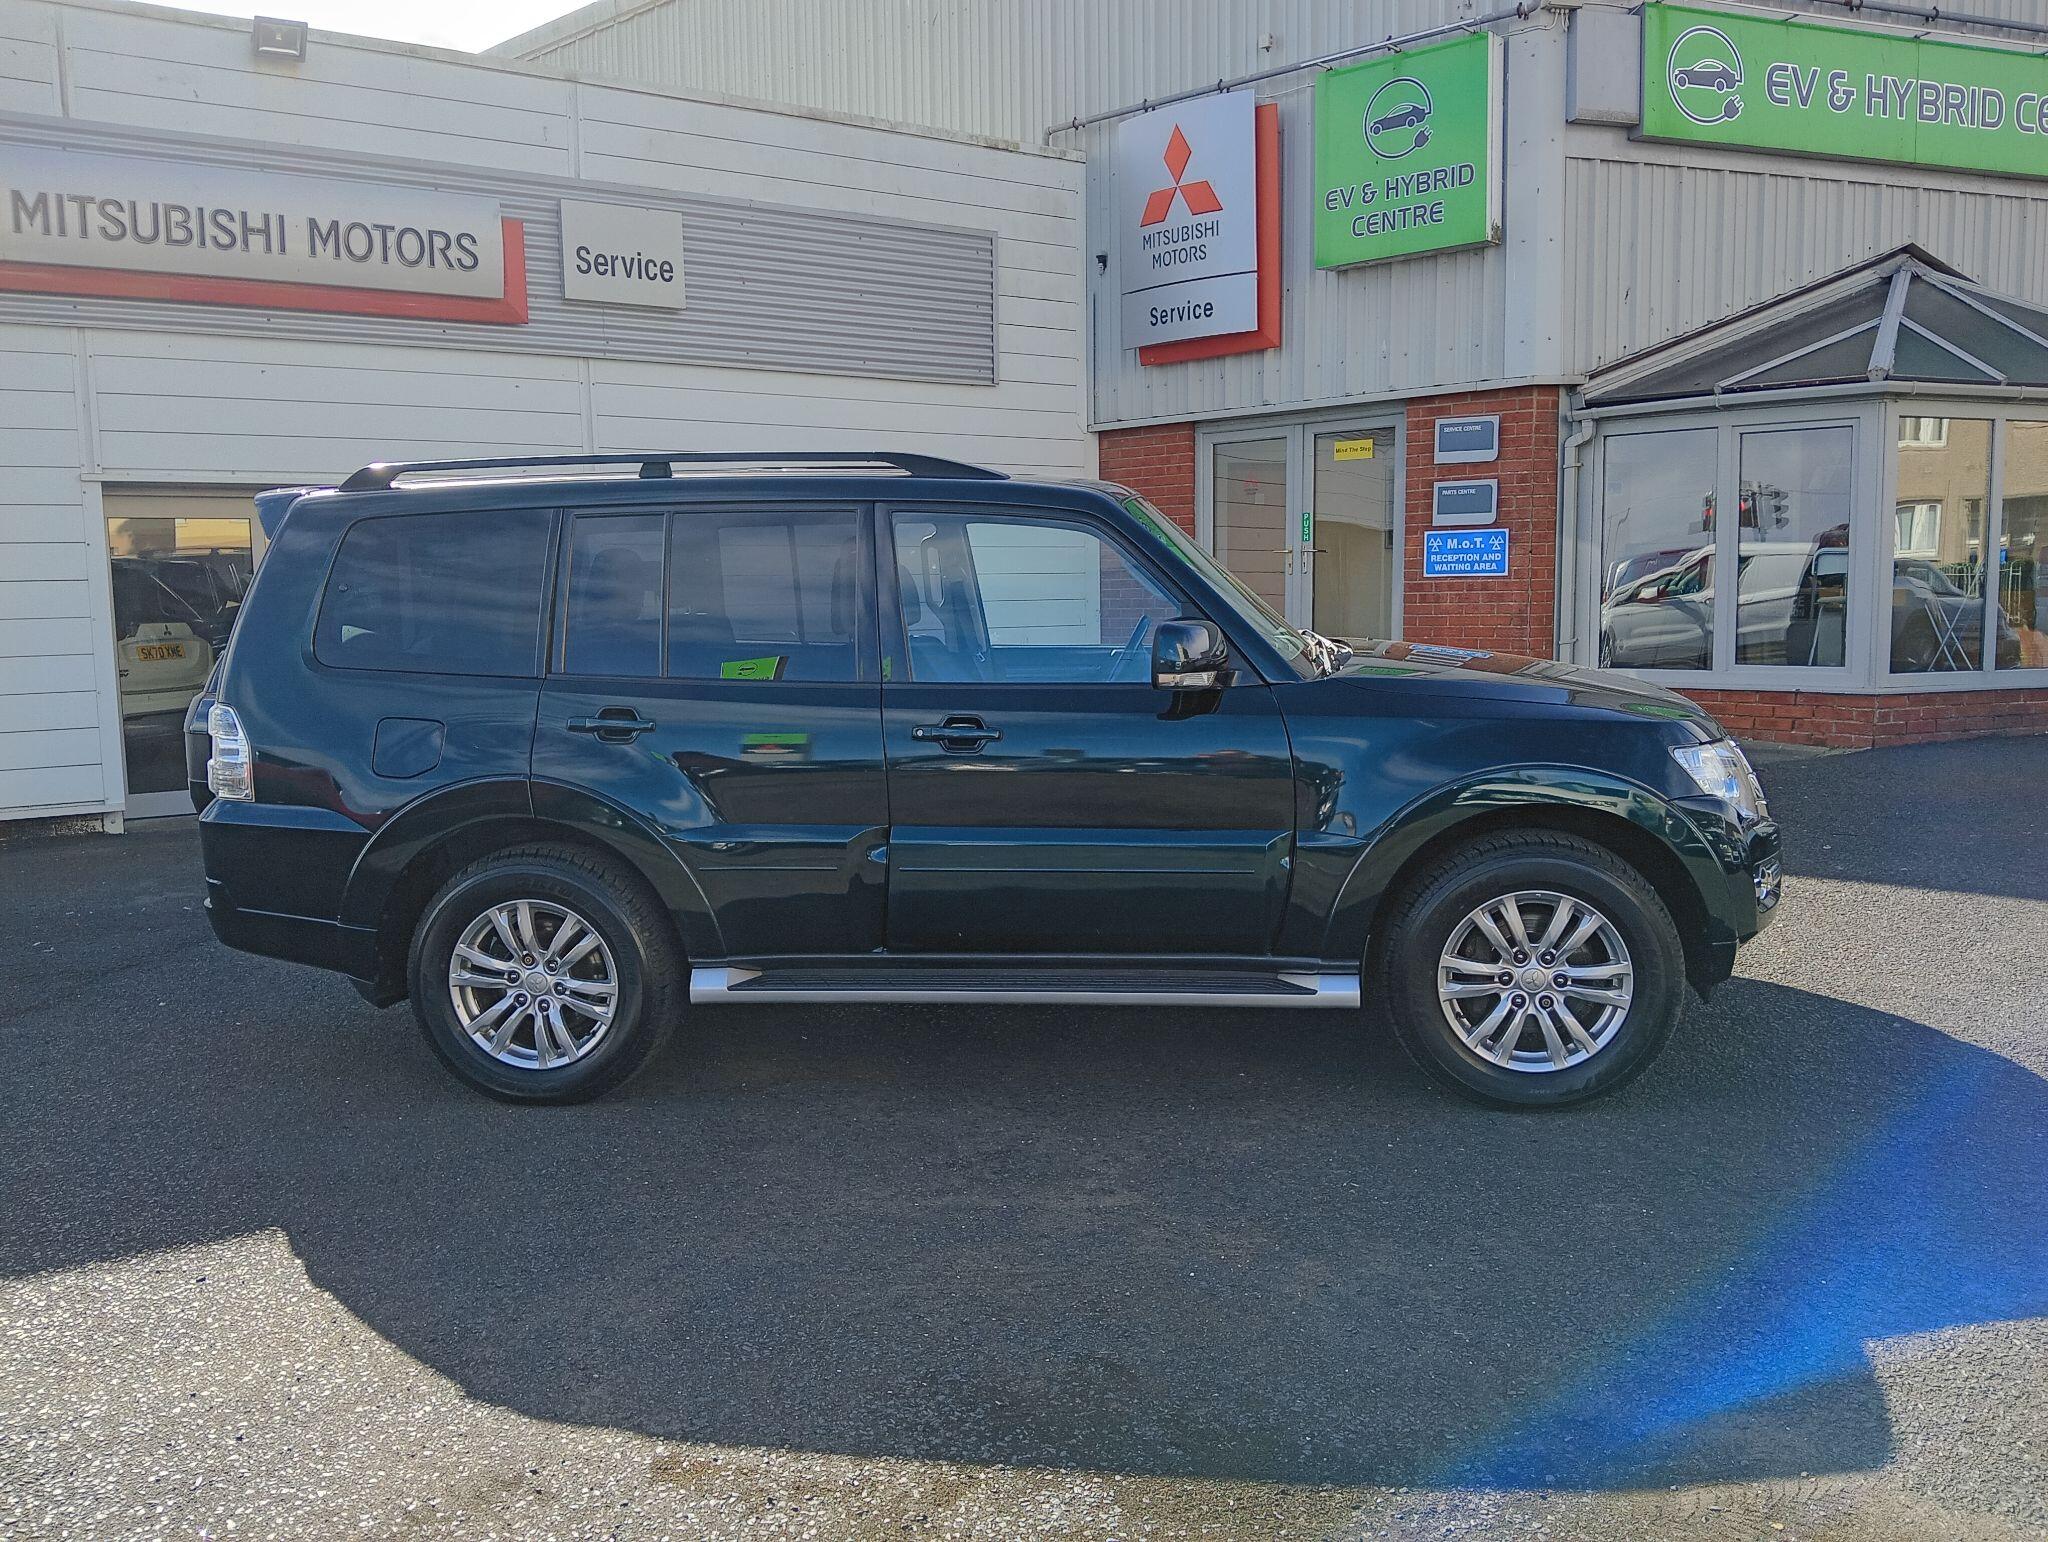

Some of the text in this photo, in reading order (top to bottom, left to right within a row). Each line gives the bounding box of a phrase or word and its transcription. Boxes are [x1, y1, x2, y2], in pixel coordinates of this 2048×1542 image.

[1765, 62, 1820, 109] EV
[1828, 70, 1857, 113] &
[1866, 74, 2006, 130] HYBRID
[1325, 163, 1475, 211] EV & HYBRID
[10, 189, 480, 273] MITSUBISHI MOTORS
[1352, 200, 1444, 238] CENTRE
[1142, 220, 1219, 251] MITSUBISHI
[575, 245, 674, 283] Service
[1152, 244, 1207, 269] MOTORS
[1150, 300, 1214, 326] Service
[1447, 537, 1485, 549] M.o.T.
[1431, 553, 1501, 562] RECEPTION AND
[1434, 562, 1498, 571] WAITING AREA
[141, 647, 164, 659] SK70
